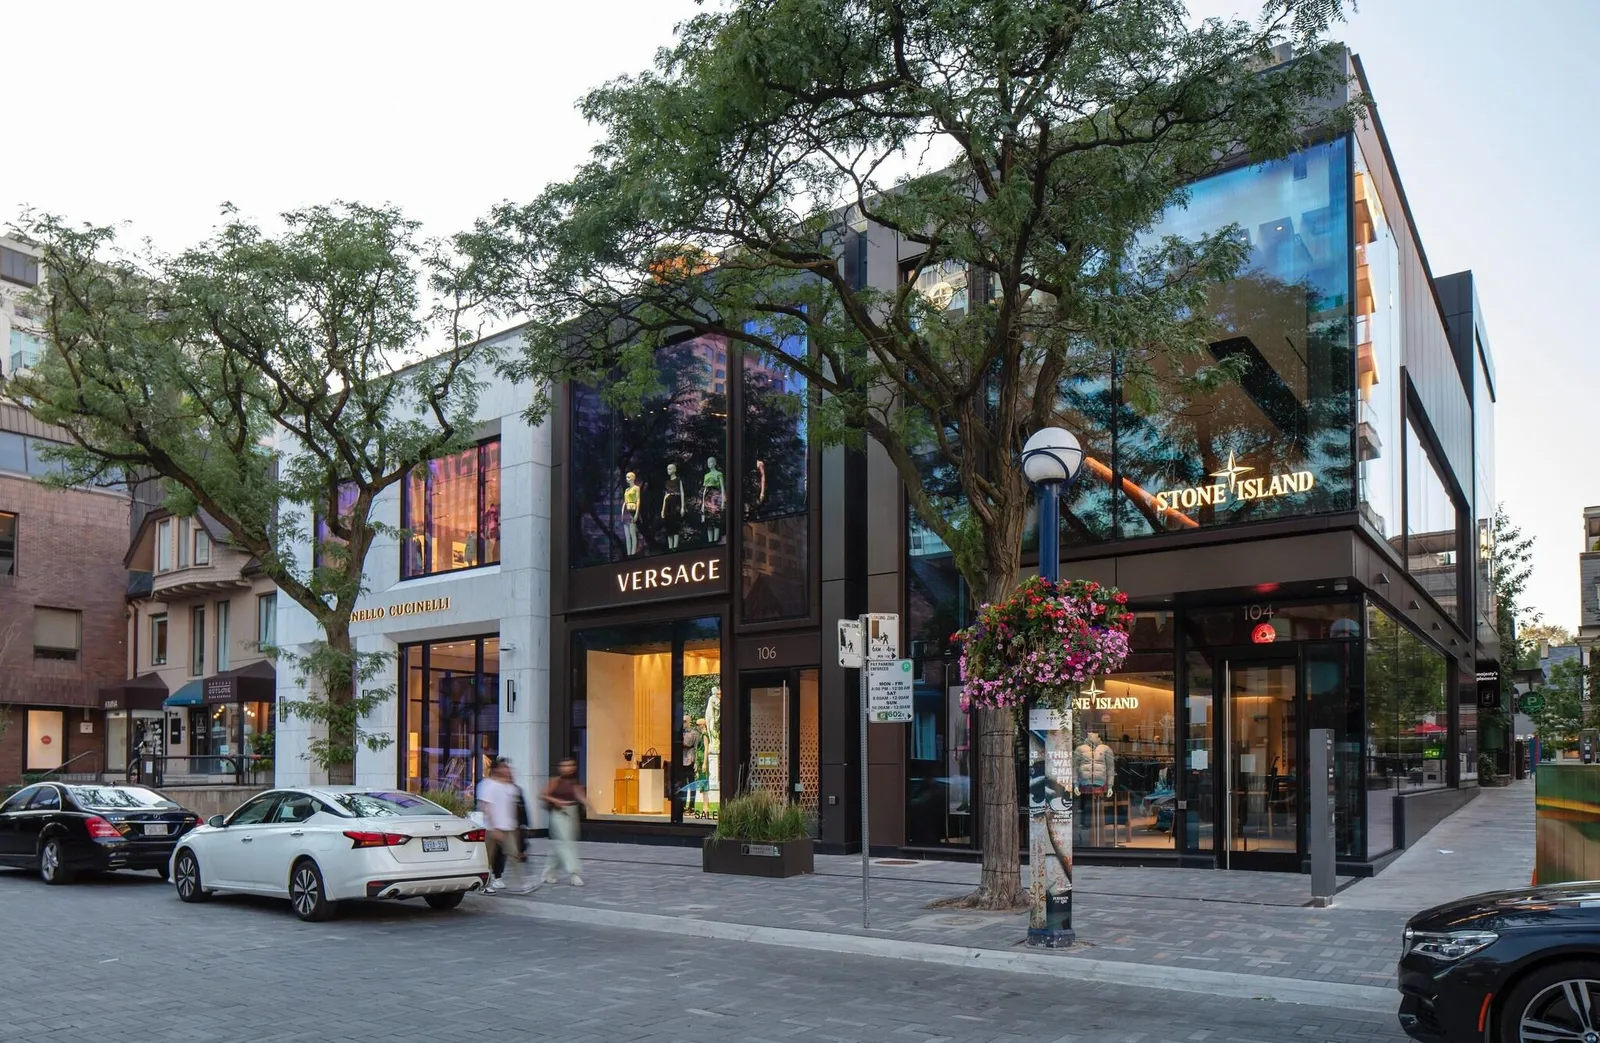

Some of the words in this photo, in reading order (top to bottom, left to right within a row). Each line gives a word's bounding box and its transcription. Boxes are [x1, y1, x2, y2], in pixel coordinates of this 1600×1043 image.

[1156, 483, 1227, 512] STONE
[1237, 471, 1315, 501] ISLAND
[617, 559, 720, 592] VERSACE
[389, 597, 451, 617] CUCINELLI
[1242, 604, 1274, 621] 104
[757, 646, 777, 660] 106
[1096, 697, 1139, 710] ISLAND
[1047, 750, 1068, 758] THIS
[694, 810, 718, 820] SALE
